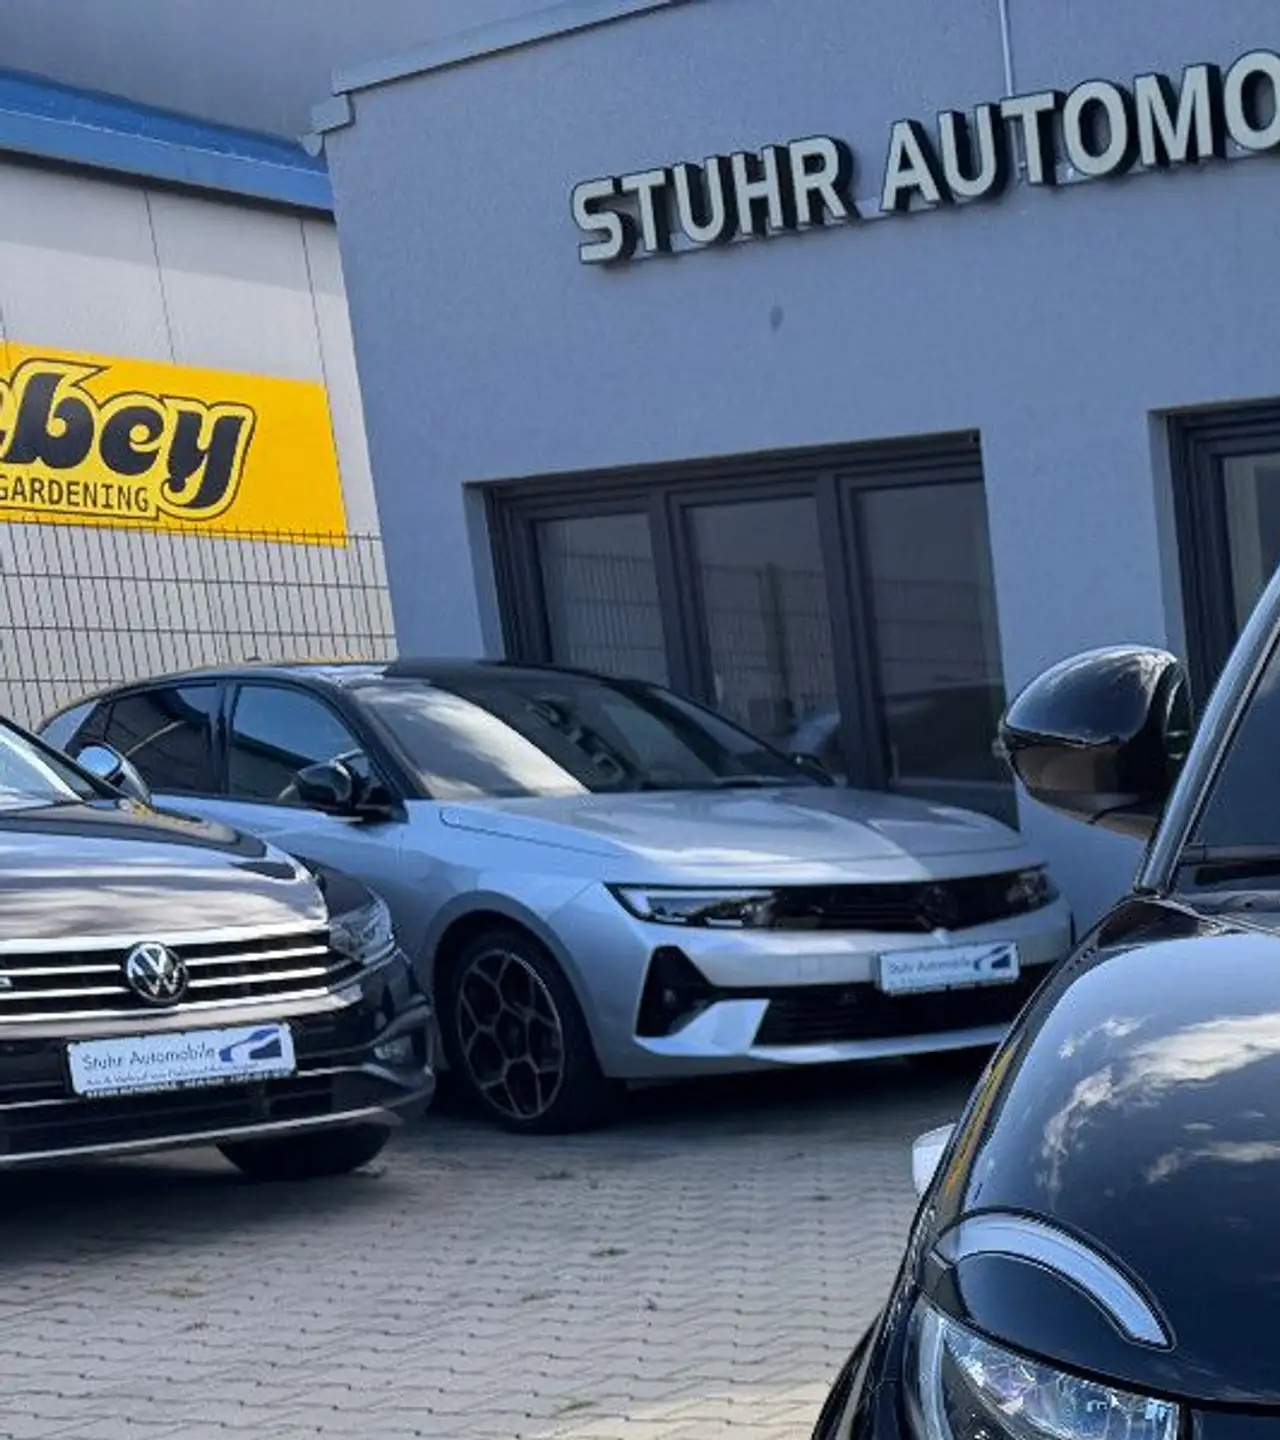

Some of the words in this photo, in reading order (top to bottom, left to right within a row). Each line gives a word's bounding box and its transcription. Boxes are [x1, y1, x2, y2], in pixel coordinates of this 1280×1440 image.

[570, 133, 856, 266] STUHR
[0, 371, 246, 508] bey
[82, 1054, 123, 1071] Stuhr
[129, 1042, 216, 1066] Automobile
